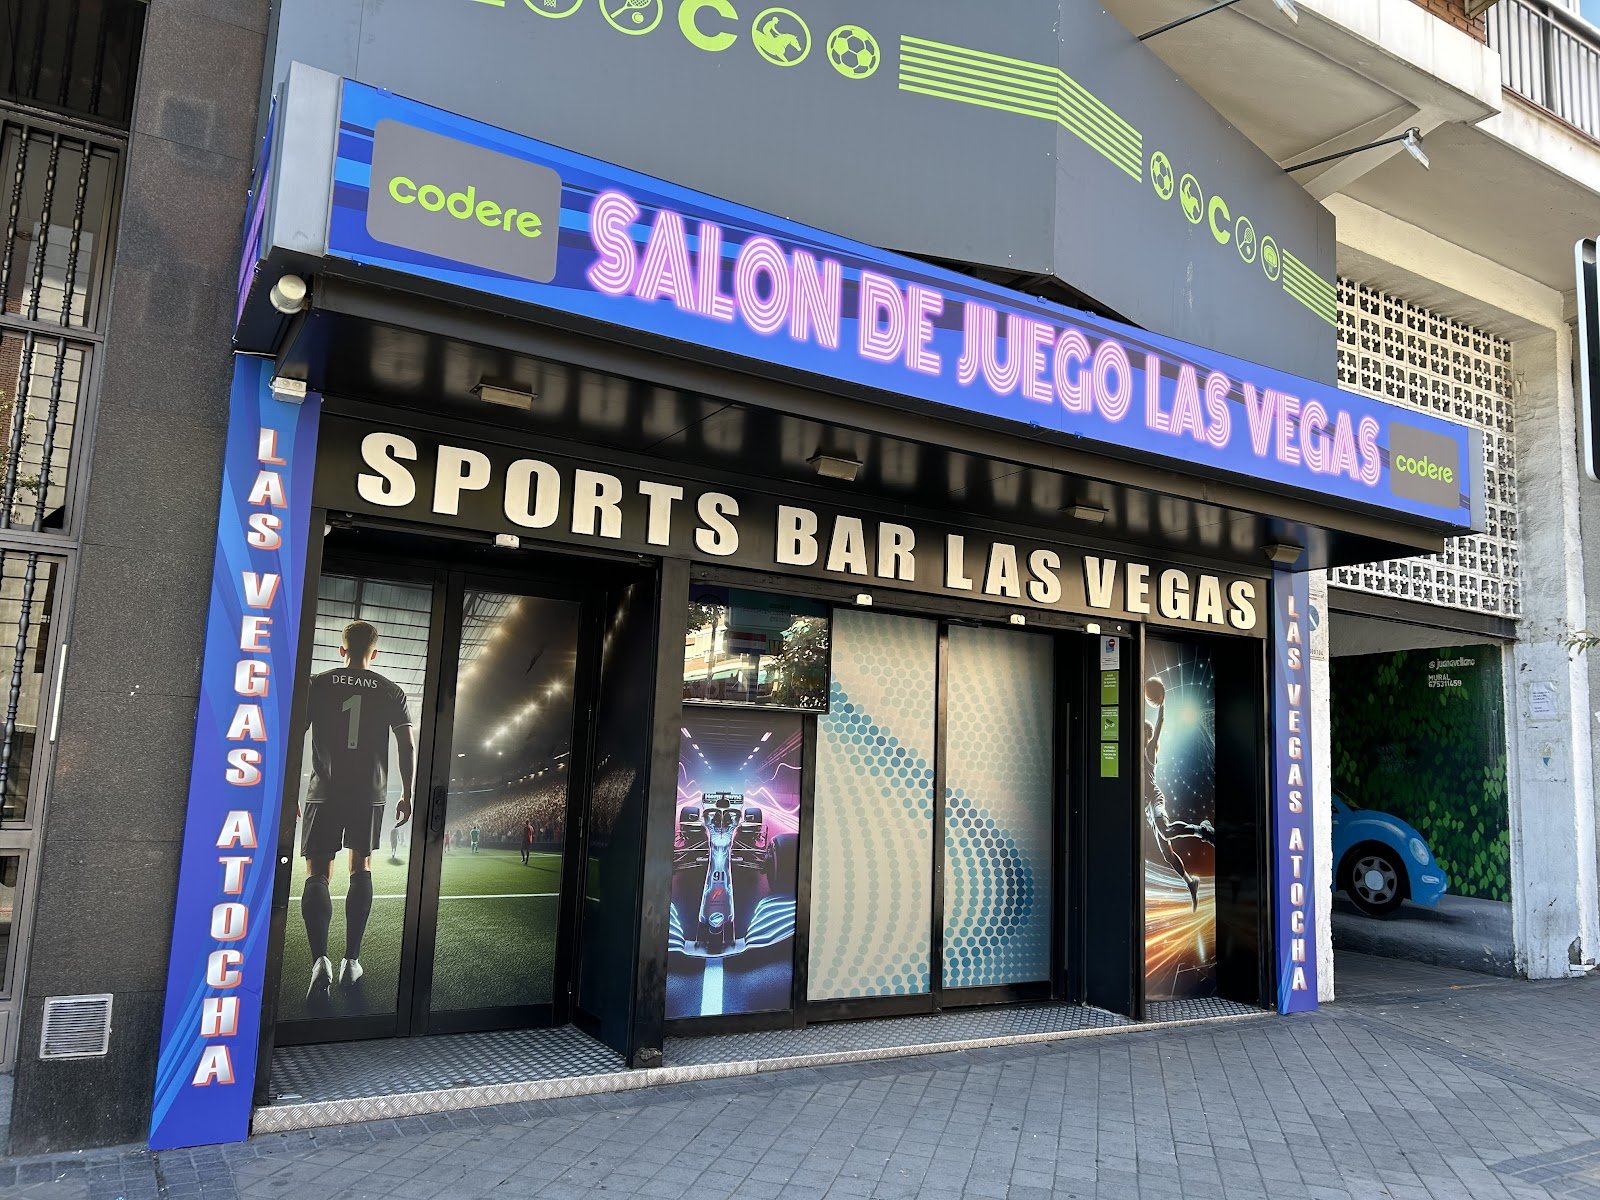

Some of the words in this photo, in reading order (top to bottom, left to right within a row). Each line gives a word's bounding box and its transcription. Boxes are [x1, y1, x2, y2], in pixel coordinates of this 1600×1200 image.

[388, 175, 543, 239] codere
[587, 190, 843, 349] SALON
[858, 270, 943, 375] DE
[957, 302, 1134, 422] JUEGO
[1145, 354, 1233, 448] LAS
[1245, 382, 1382, 486] VEGAS
[247, 427, 288, 550] LAS
[357, 432, 740, 556] SPORTS
[775, 504, 917, 582] BAR
[945, 533, 1062, 604] LAS
[1084, 555, 1258, 630] VEGAS
[1395, 453, 1454, 484] codere
[226, 571, 281, 788] VEGAS
[332, 674, 378, 689] DEEANS
[1287, 595, 1302, 670] LAS
[342, 694, 362, 750] 1
[1287, 683, 1304, 814] VEGAS
[192, 810, 258, 1087] ATOCHA
[1289, 827, 1308, 991] ATOCHA
